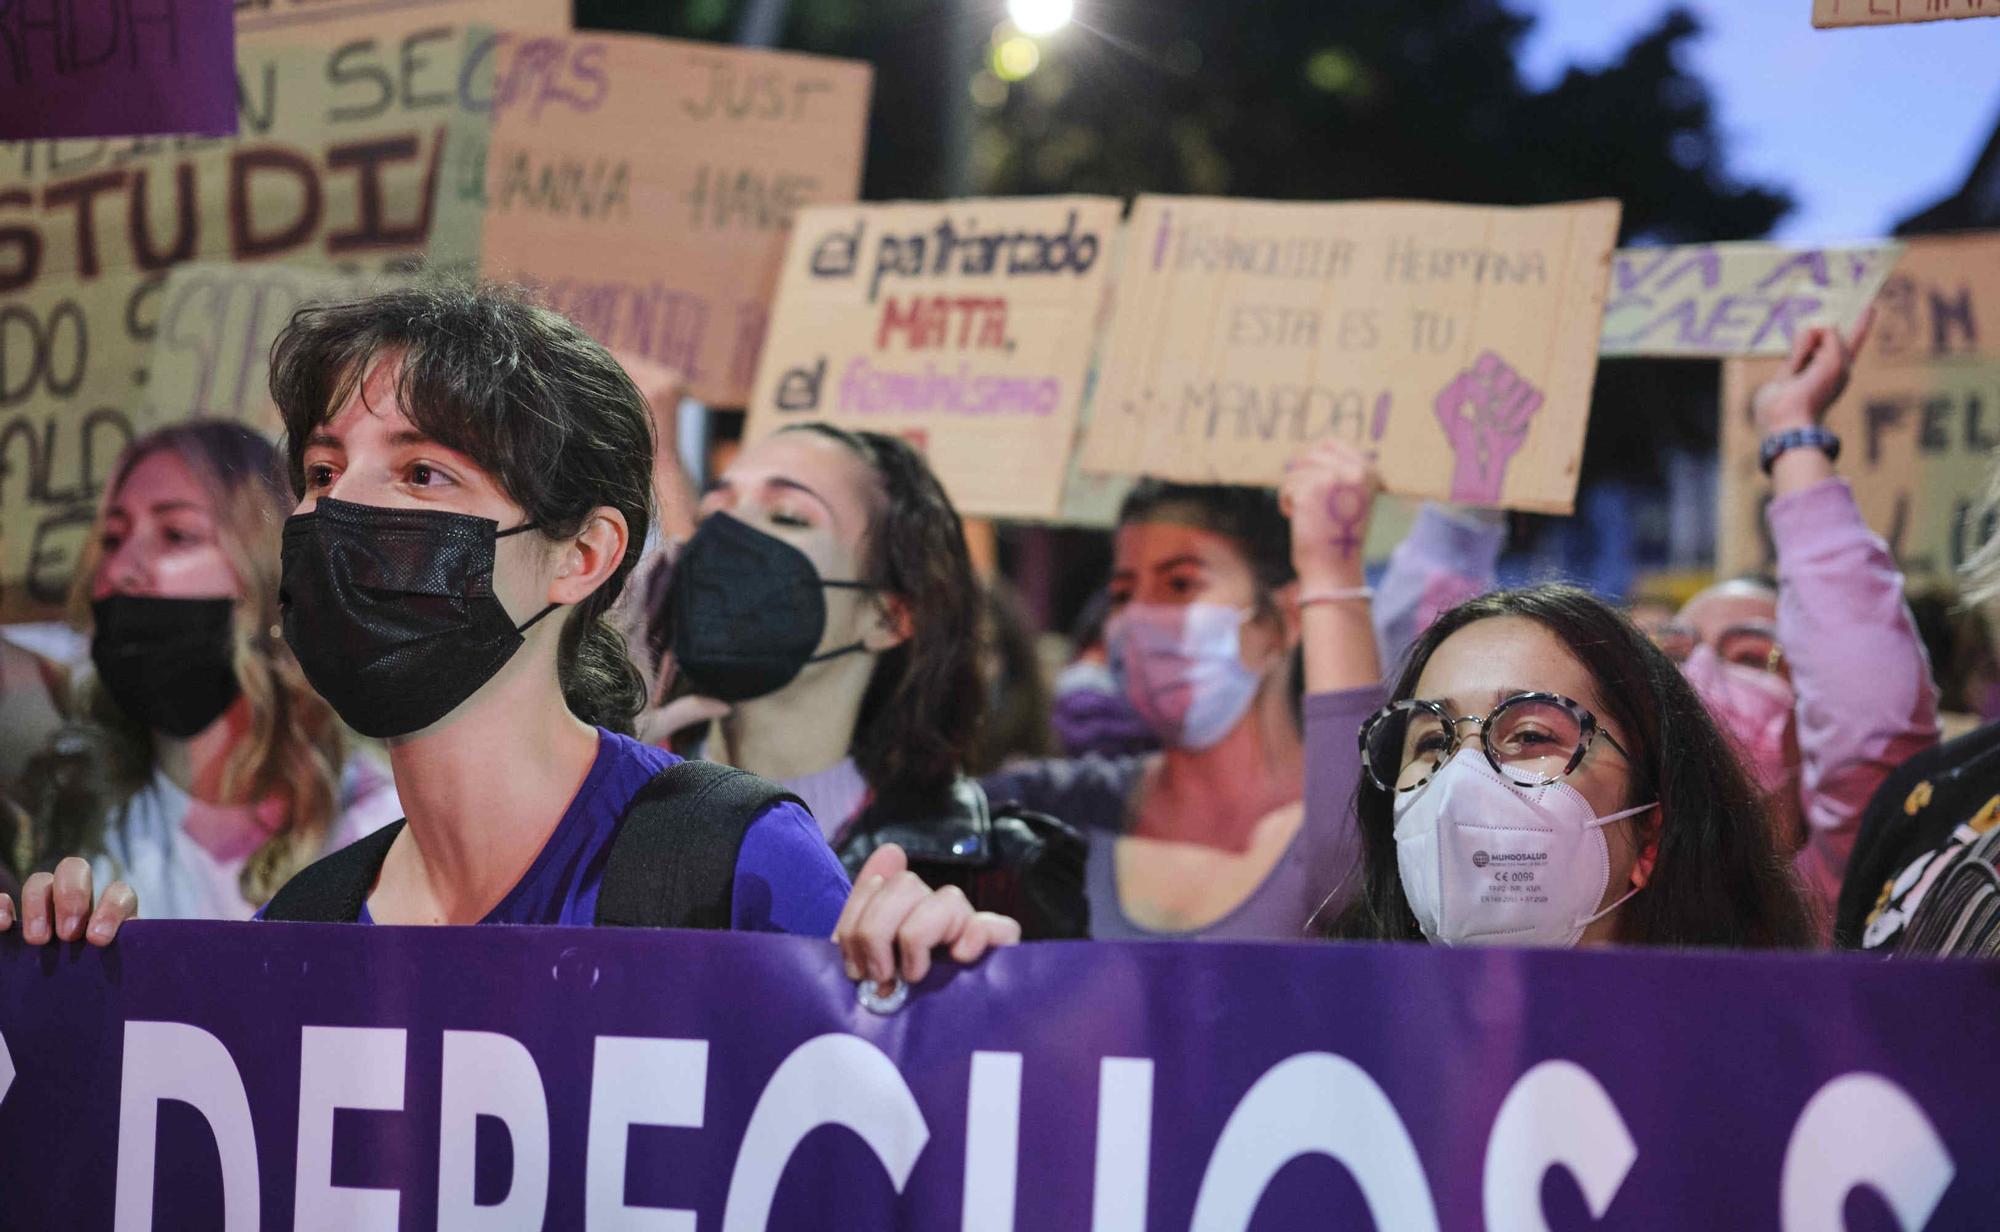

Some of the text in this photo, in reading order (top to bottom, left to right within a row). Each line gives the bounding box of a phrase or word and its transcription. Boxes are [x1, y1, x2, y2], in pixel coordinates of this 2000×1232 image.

[868, 206, 1099, 302] patriarcado
[1409, 311, 1457, 357] TU
[1491, 852, 1548, 861] MUNDOSALUD
